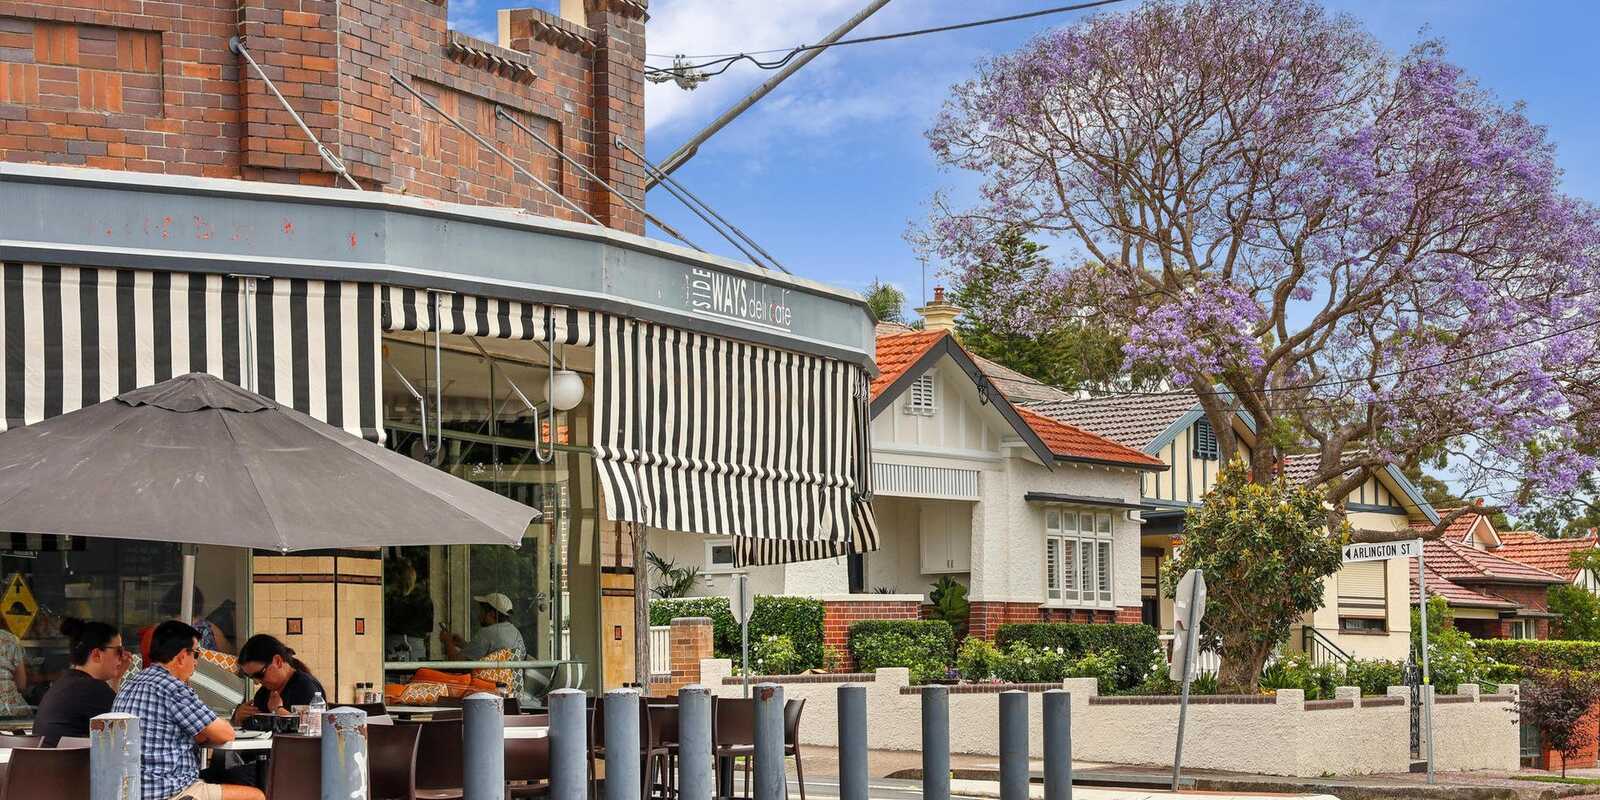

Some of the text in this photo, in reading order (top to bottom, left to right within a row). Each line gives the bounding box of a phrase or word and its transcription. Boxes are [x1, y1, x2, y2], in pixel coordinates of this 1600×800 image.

[692, 268, 711, 309] SIDE
[712, 272, 747, 317] WAYS
[1353, 543, 1411, 559] ARLINGTON ST
